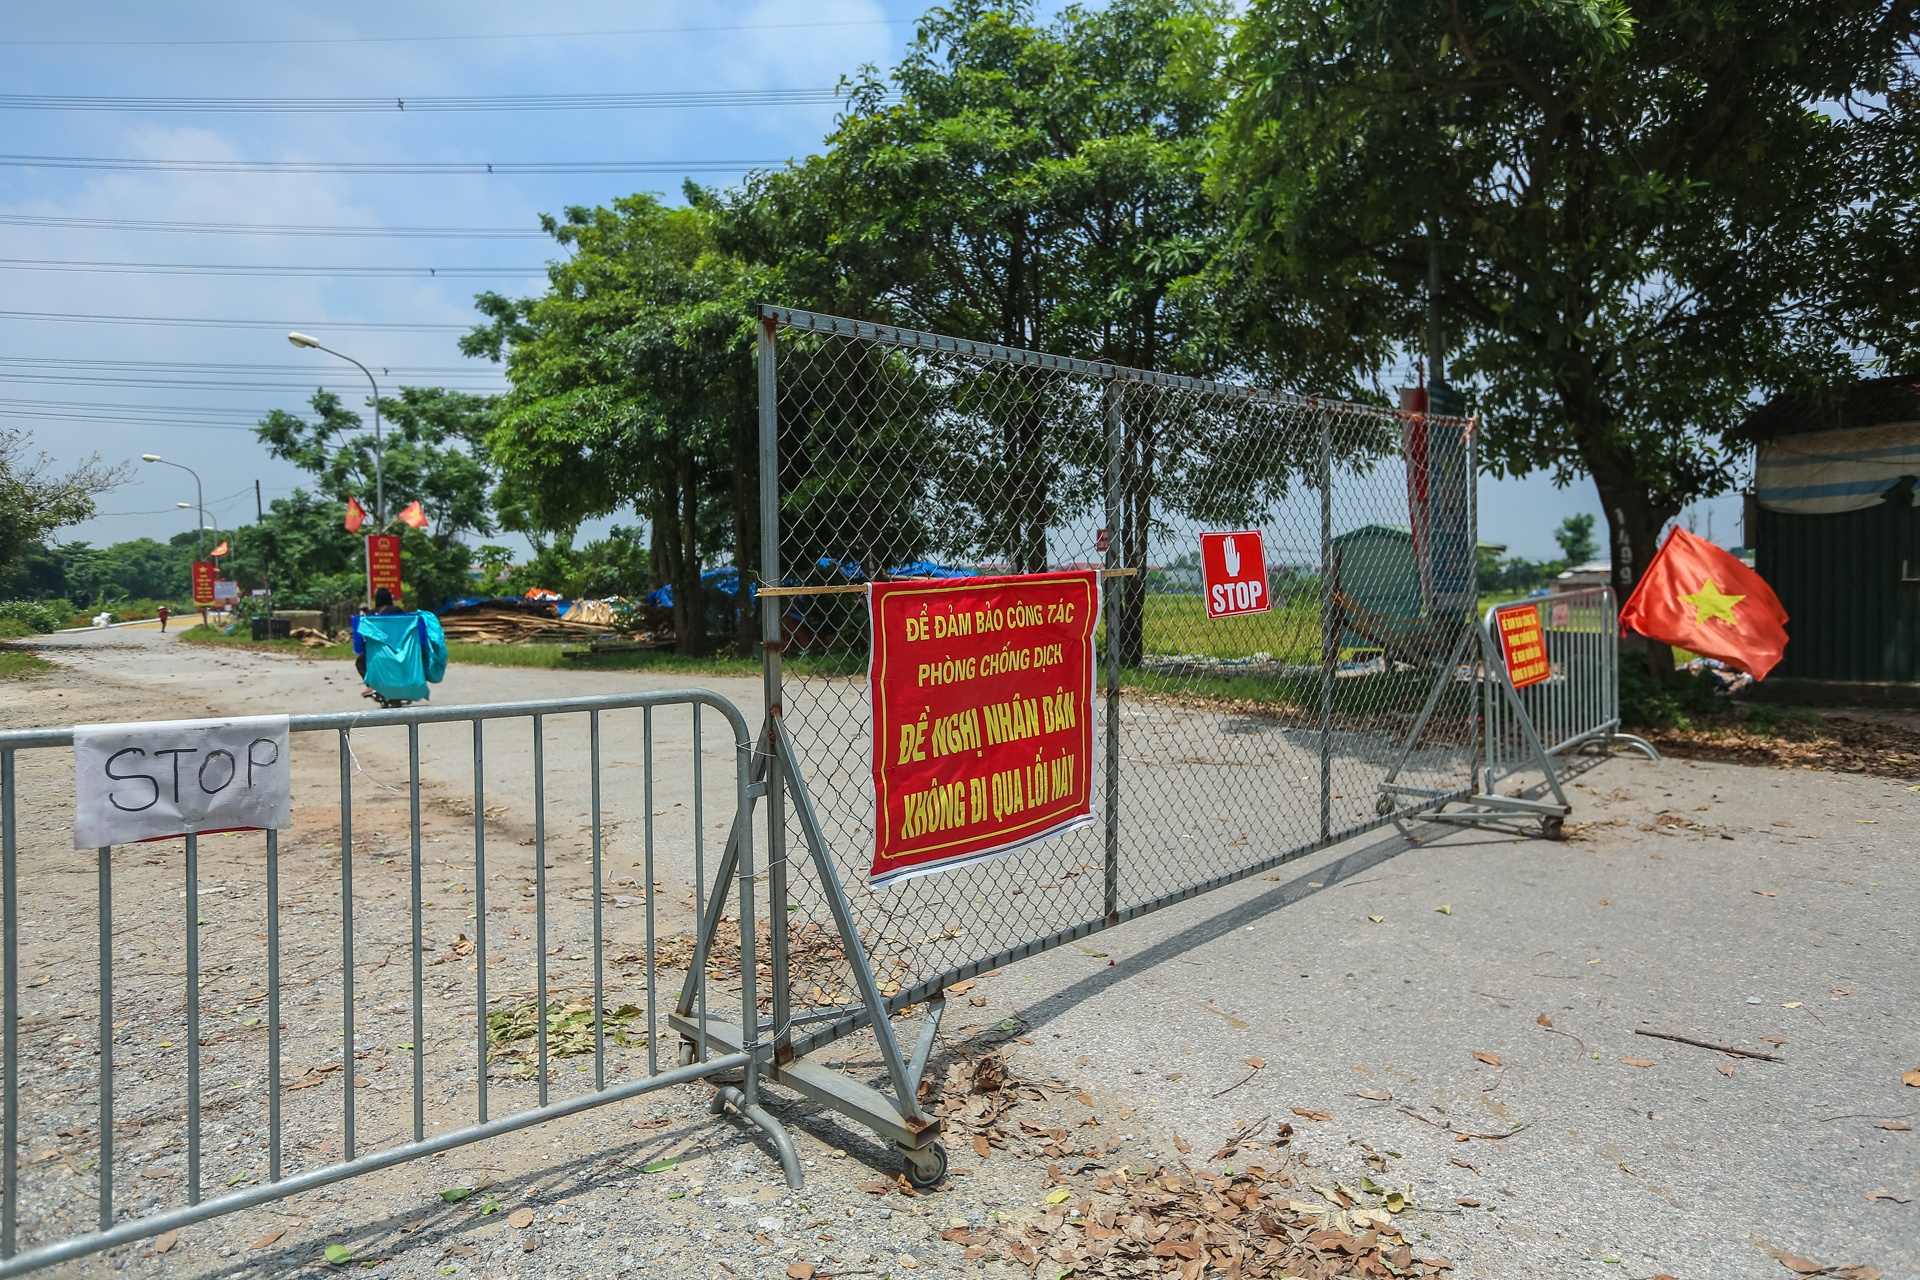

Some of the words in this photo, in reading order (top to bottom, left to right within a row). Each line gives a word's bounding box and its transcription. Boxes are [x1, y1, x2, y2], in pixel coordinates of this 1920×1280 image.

[906, 602, 930, 642] ĐỂ
[934, 603, 972, 639] ĐẢM
[976, 600, 1004, 633] BẢO
[1006, 600, 1043, 630] CÔNG
[1047, 597, 1075, 624] TÁC
[1212, 580, 1263, 613] STOP
[917, 654, 976, 687] PHÒNG
[979, 640, 1030, 677] CHỐNG
[1033, 643, 1064, 674] DỊCH
[898, 705, 931, 766] ĐỀ
[931, 707, 983, 759] NGHỊ
[983, 692, 1040, 746] NHÂN
[1043, 685, 1077, 734] DÂN
[105, 737, 279, 812] STOP
[901, 777, 966, 840] KHÔNG
[970, 776, 988, 824] ĐI
[992, 767, 1024, 824] QUA
[1027, 746, 1048, 808] LỐI
[1051, 747, 1076, 800] NÀY
